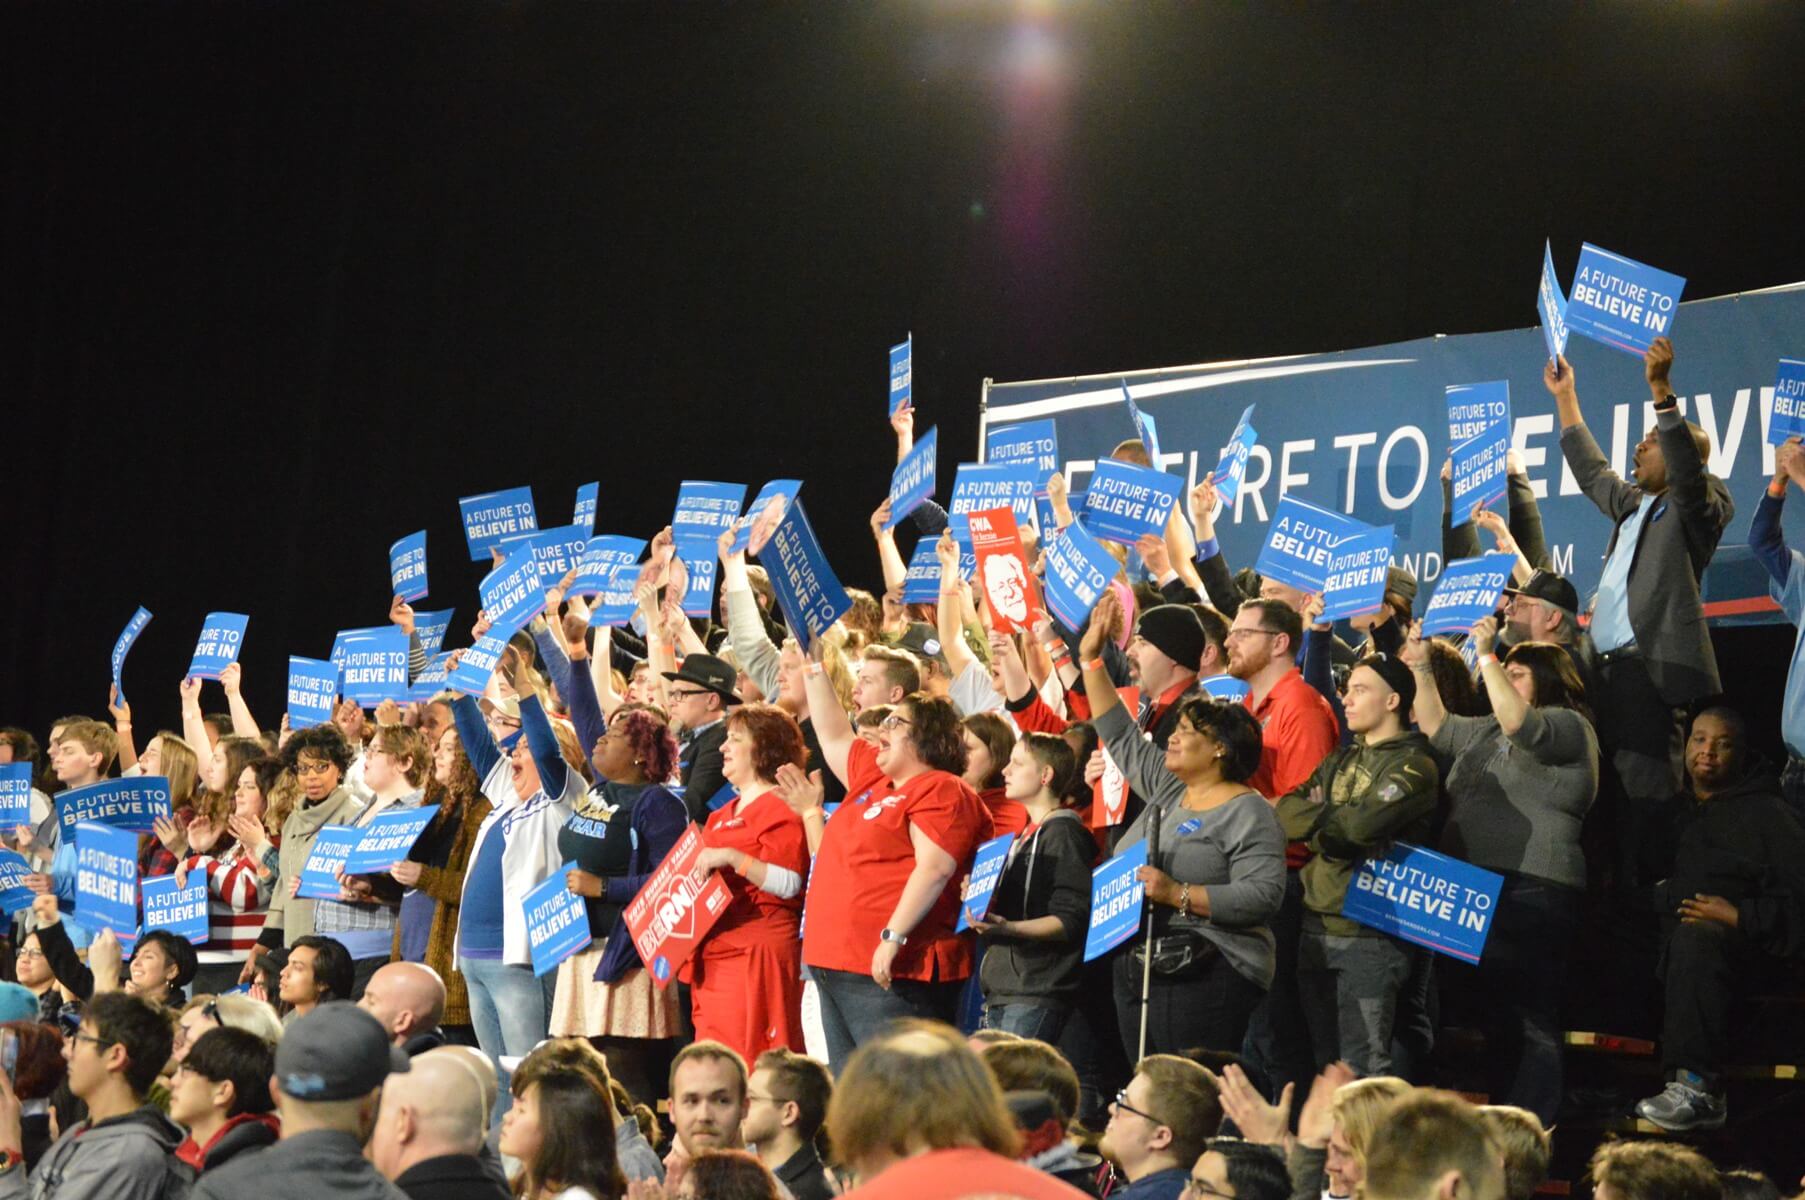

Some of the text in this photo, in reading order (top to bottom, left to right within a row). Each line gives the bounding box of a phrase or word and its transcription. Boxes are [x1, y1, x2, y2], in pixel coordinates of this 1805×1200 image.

[1580, 266, 1673, 311] A FUTURE TO
[1574, 283, 1643, 324] BELIEVE
[1644, 310, 1667, 333] IN
[1777, 378, 1805, 397] A FUT
[1452, 401, 1505, 418] FUTURE TO
[1774, 396, 1805, 418] BELIE
[995, 441, 1034, 458] FUTURE
[1036, 438, 1053, 453] TO
[1455, 438, 1506, 478] A FUTURE TO
[1040, 455, 1055, 470] IN
[1334, 424, 1429, 514] TO
[1455, 455, 1506, 498] BELIEVE IN
[957, 480, 1033, 496] A FUTURE TO
[1093, 476, 1173, 508] A FUTURE TO
[467, 502, 531, 524] A FUTURE TO
[724, 499, 739, 512] TO
[1013, 497, 1029, 513] IN
[1086, 491, 1144, 520] BELIEVE
[1145, 508, 1167, 527] IN
[468, 516, 534, 539] BELIEVE IN
[675, 511, 735, 528] BELIEVE IN
[970, 516, 992, 532] CWA
[1044, 512, 1050, 524] A
[1278, 516, 1338, 548] A FUTU
[413, 548, 424, 559] TO
[531, 540, 585, 561] TURE TO
[617, 552, 635, 565] TO
[1270, 531, 1332, 568] BELIE
[1329, 561, 1335, 572] A
[1335, 549, 1372, 571] FUTURE
[1374, 547, 1389, 563] TO
[414, 561, 425, 575] IN
[694, 560, 713, 574] TO
[784, 520, 835, 620] A FUTURE TO
[1059, 532, 1106, 589] UTURE TO
[483, 594, 488, 607] A
[488, 571, 521, 602] FUTURE
[522, 560, 535, 577] TO
[692, 576, 711, 591] IN
[774, 530, 824, 633] BELIEVE IN
[1323, 568, 1370, 592] BELIEVE
[1371, 565, 1386, 584] IN
[1439, 573, 1504, 589] A FUTURE TO
[484, 575, 540, 622] BELIEVE IN
[1429, 589, 1497, 610] BELIEVE IN
[222, 629, 239, 642] TO
[430, 636, 442, 648] IN
[494, 639, 505, 651] TO
[218, 643, 236, 659] IN
[346, 654, 351, 666] A
[351, 653, 385, 666] FUTURE
[388, 652, 405, 665] TO
[290, 674, 334, 692] A FUTURE TO
[345, 668, 385, 683] BELIEVE
[389, 668, 405, 683] IN
[289, 690, 332, 710] BELIEVE IN
[0, 779, 29, 791] URE TO
[15, 794, 28, 808] IN
[63, 790, 166, 813] A FUTURE TO
[63, 801, 168, 826] BELIEVE IN
[366, 820, 427, 837] A FUTURE TO
[314, 841, 353, 858] A FUTURE
[356, 834, 418, 852] BELIEVE IN
[79, 848, 135, 878] A FUTURE TO
[306, 856, 346, 873] BELIEV
[78, 869, 134, 906] BELIEVE IN
[1094, 864, 1143, 905] A FUTURE T
[1364, 859, 1491, 910] A FUTURE TO
[147, 886, 206, 909] A FUTURE TO
[1092, 885, 1143, 928] BELIEVE IN
[1356, 871, 1486, 933] BELIEVE IN
[147, 901, 207, 926] BELIEVE IN
[528, 911, 535, 927] A
[534, 891, 565, 922] FUTURE
[638, 867, 709, 961] BERNIE
[530, 899, 584, 947] BELIEVE IN
